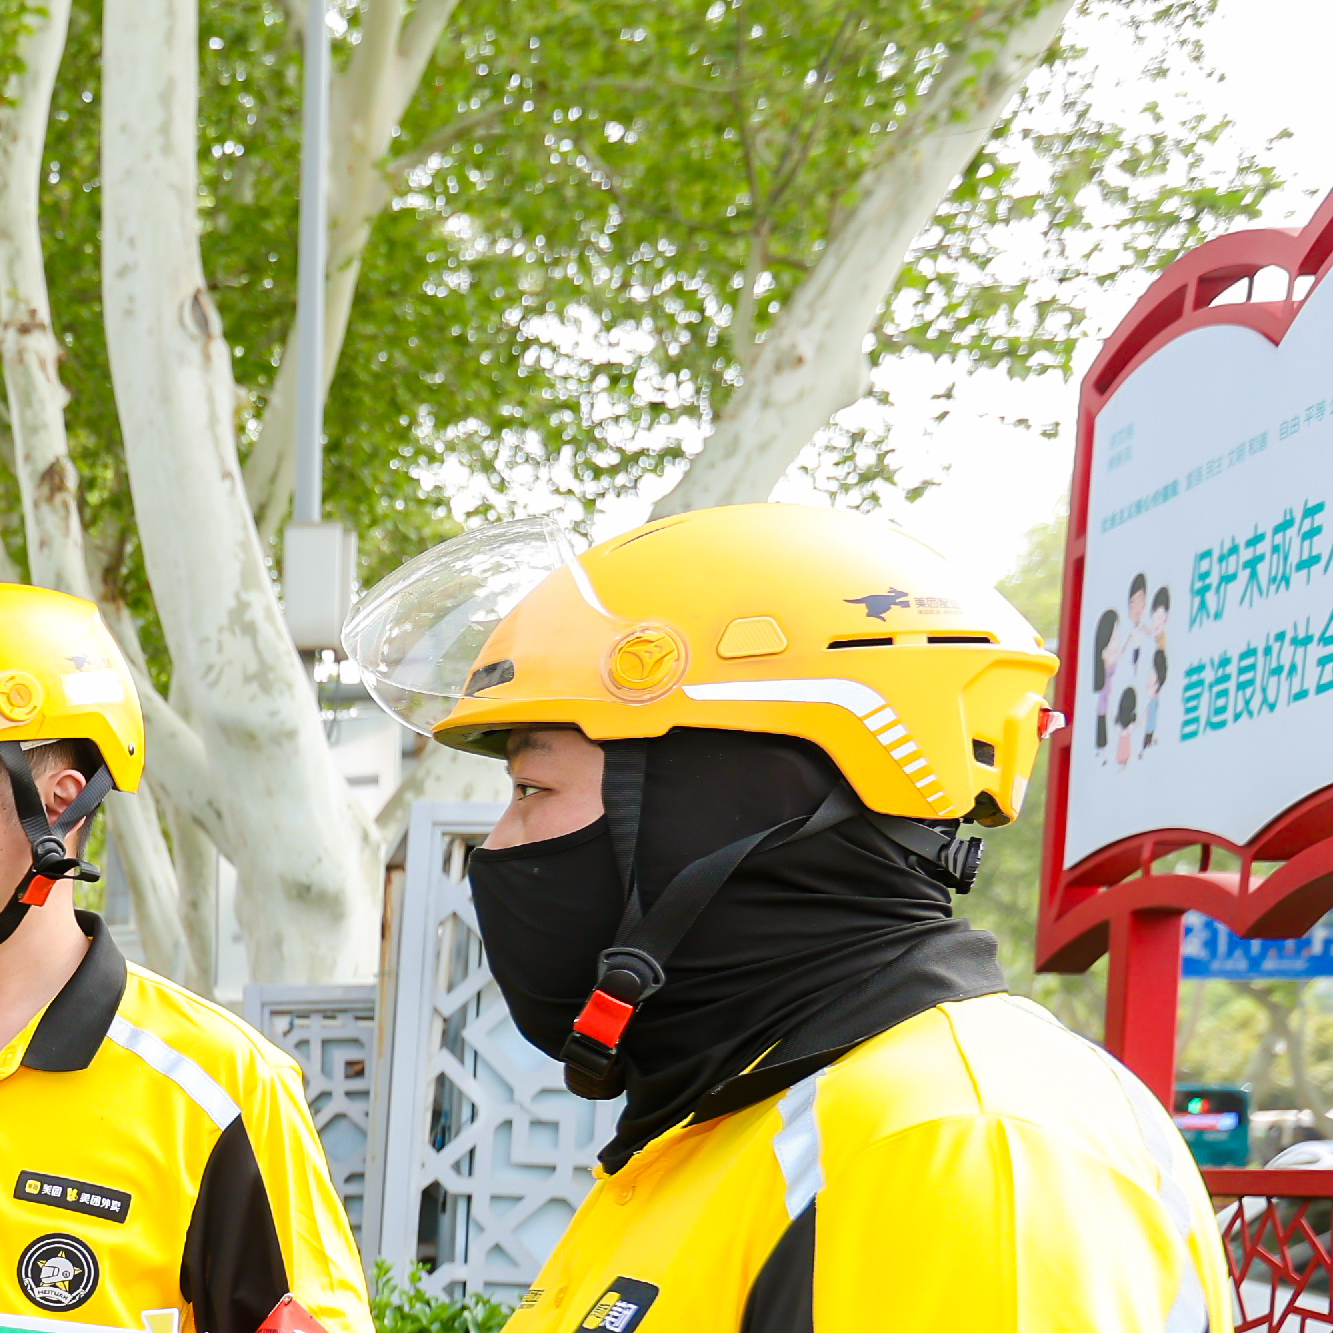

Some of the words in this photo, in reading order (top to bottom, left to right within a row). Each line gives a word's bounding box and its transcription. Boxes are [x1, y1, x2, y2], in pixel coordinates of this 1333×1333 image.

[1189, 498, 1333, 633] 保护未成年
